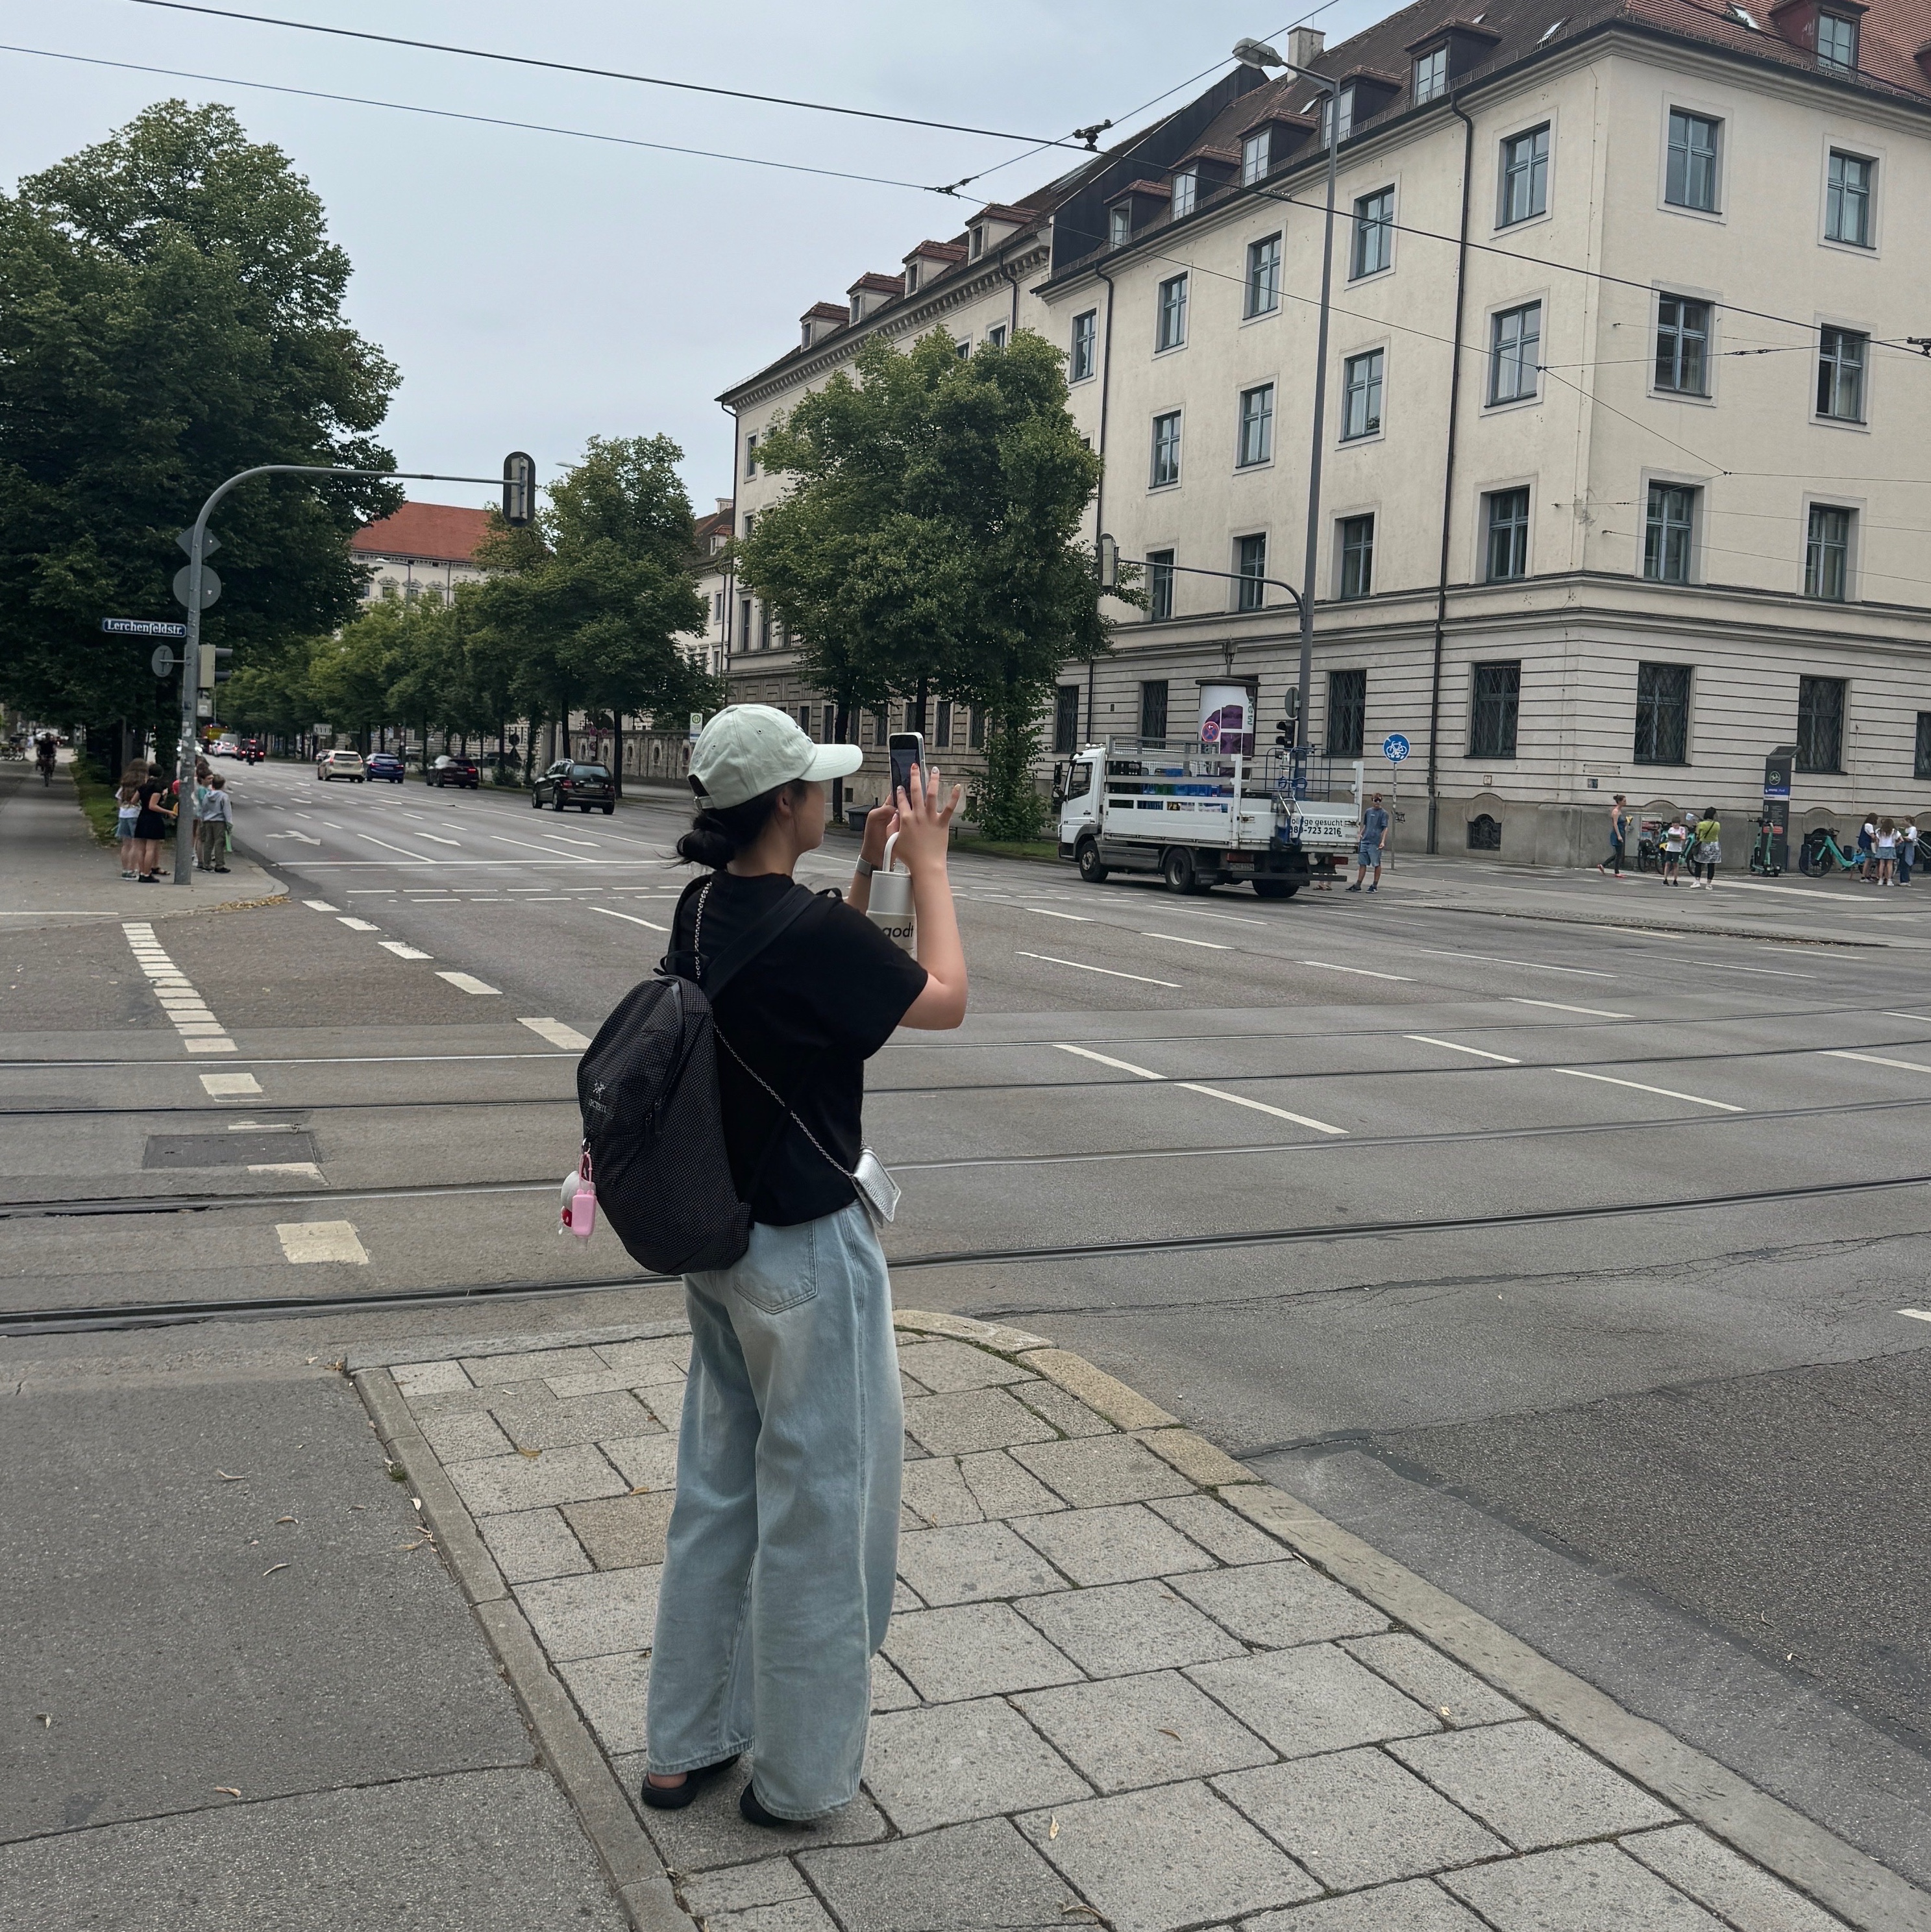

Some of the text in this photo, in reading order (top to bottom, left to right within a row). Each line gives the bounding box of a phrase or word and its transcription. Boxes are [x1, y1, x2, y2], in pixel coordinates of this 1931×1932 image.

[107, 620, 182, 635] Lerchenfeldstr.
[1290, 818, 1343, 827] ollge gesucht
[1323, 826, 1342, 836] 2216
